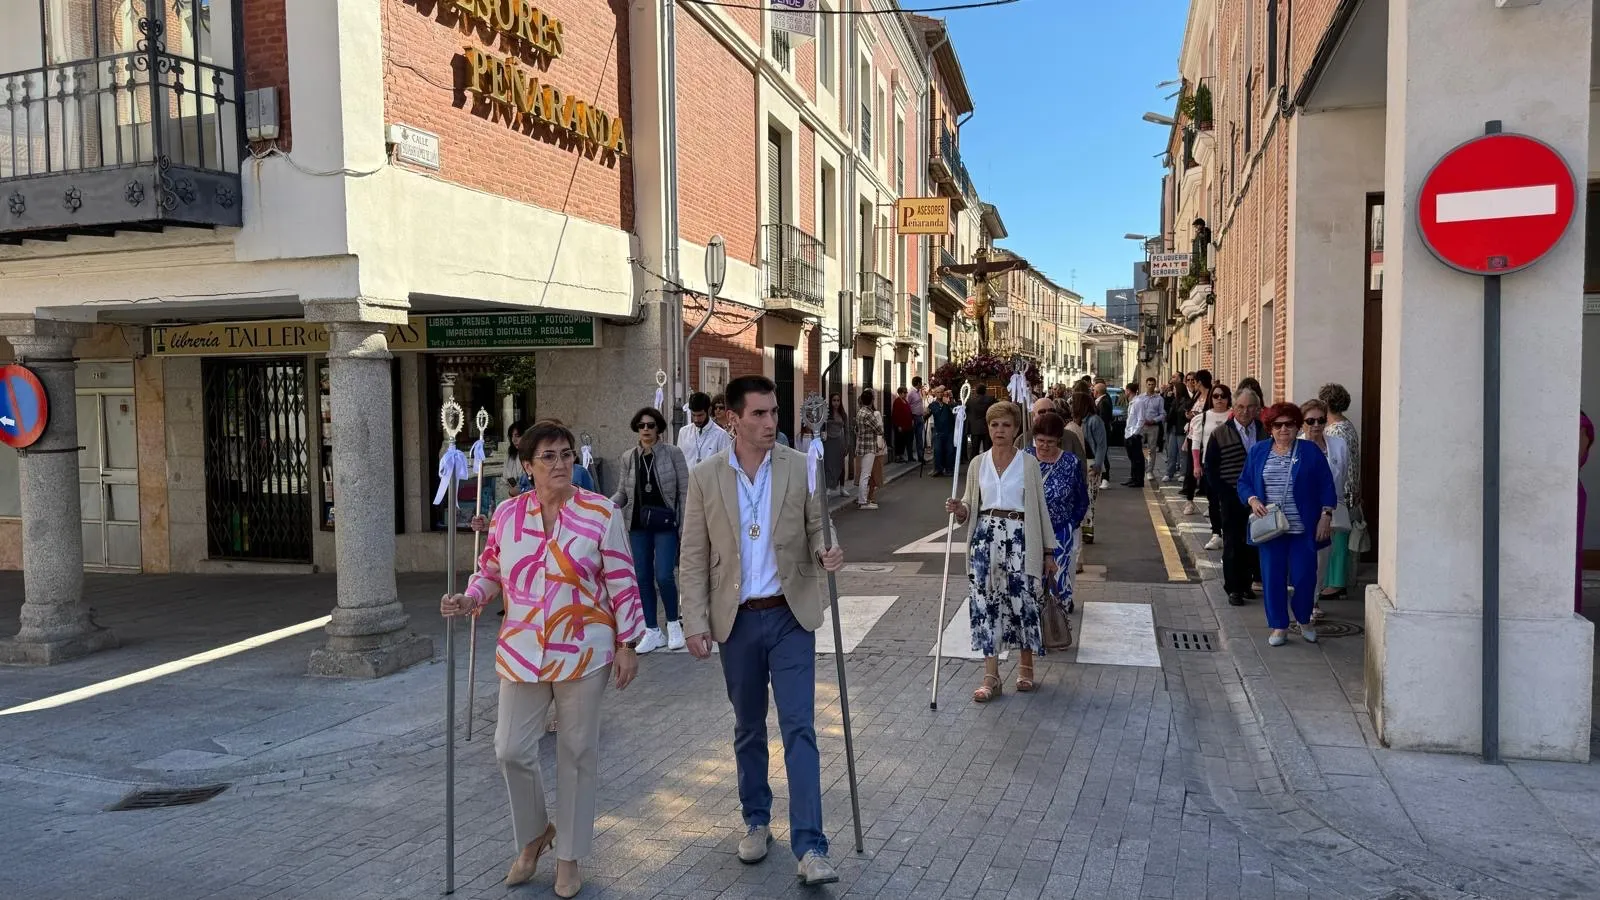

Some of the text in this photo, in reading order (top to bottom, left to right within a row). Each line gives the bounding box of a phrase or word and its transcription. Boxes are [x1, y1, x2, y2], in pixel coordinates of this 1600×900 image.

[412, 134, 428, 146] CALLE
[917, 205, 944, 215] ASESORES
[903, 207, 944, 227] Peñaranda
[429, 317, 454, 327] LIBROS
[462, 316, 490, 325] PRENSA
[545, 314, 591, 323] FOTOCOPIAS
[171, 331, 220, 348] librería
[225, 326, 306, 348] TALLER
[307, 328, 328, 341] de
[446, 326, 574, 337] IMPRESIONES DIGITALES REGALOS
